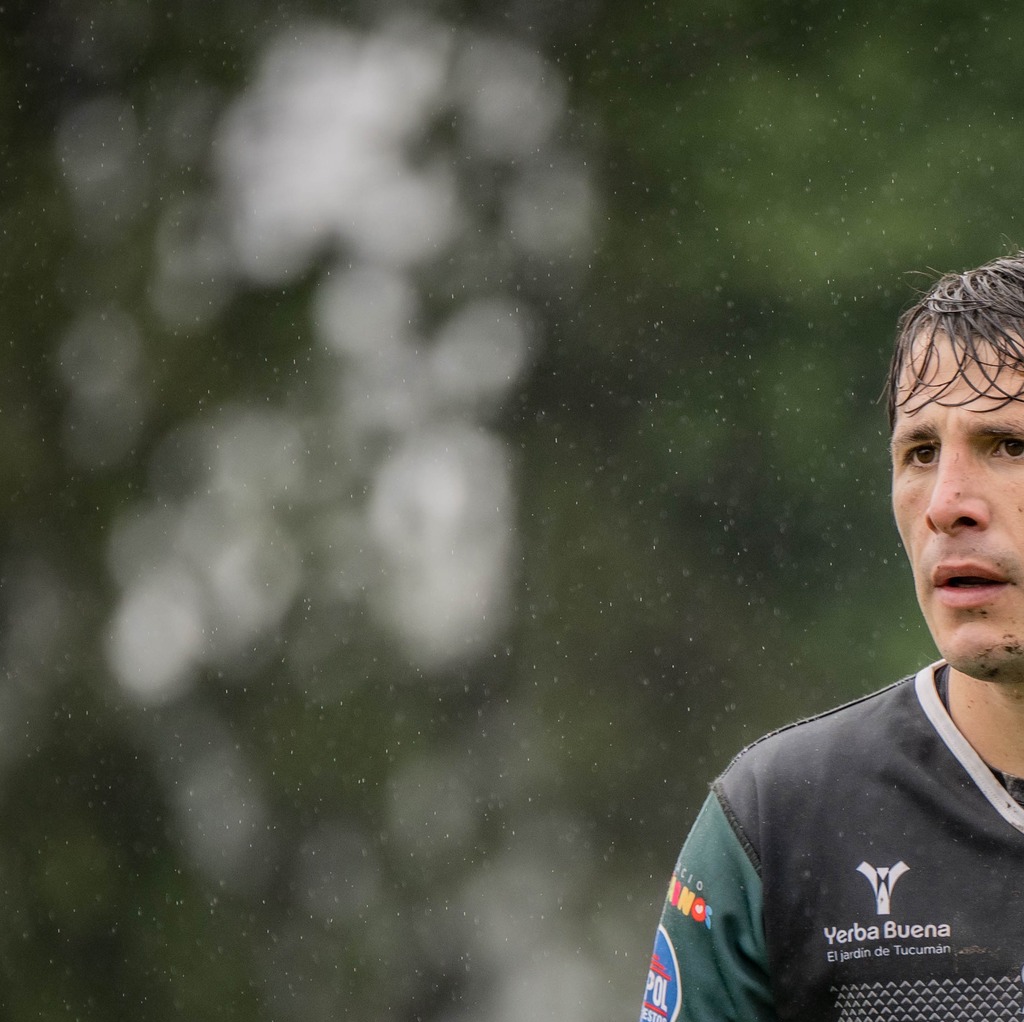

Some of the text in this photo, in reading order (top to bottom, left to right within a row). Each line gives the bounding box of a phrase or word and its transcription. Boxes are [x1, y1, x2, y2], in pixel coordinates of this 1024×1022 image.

[823, 920, 951, 945] Yerba Buena
[827, 951, 838, 962] El
[874, 946, 891, 957] de
